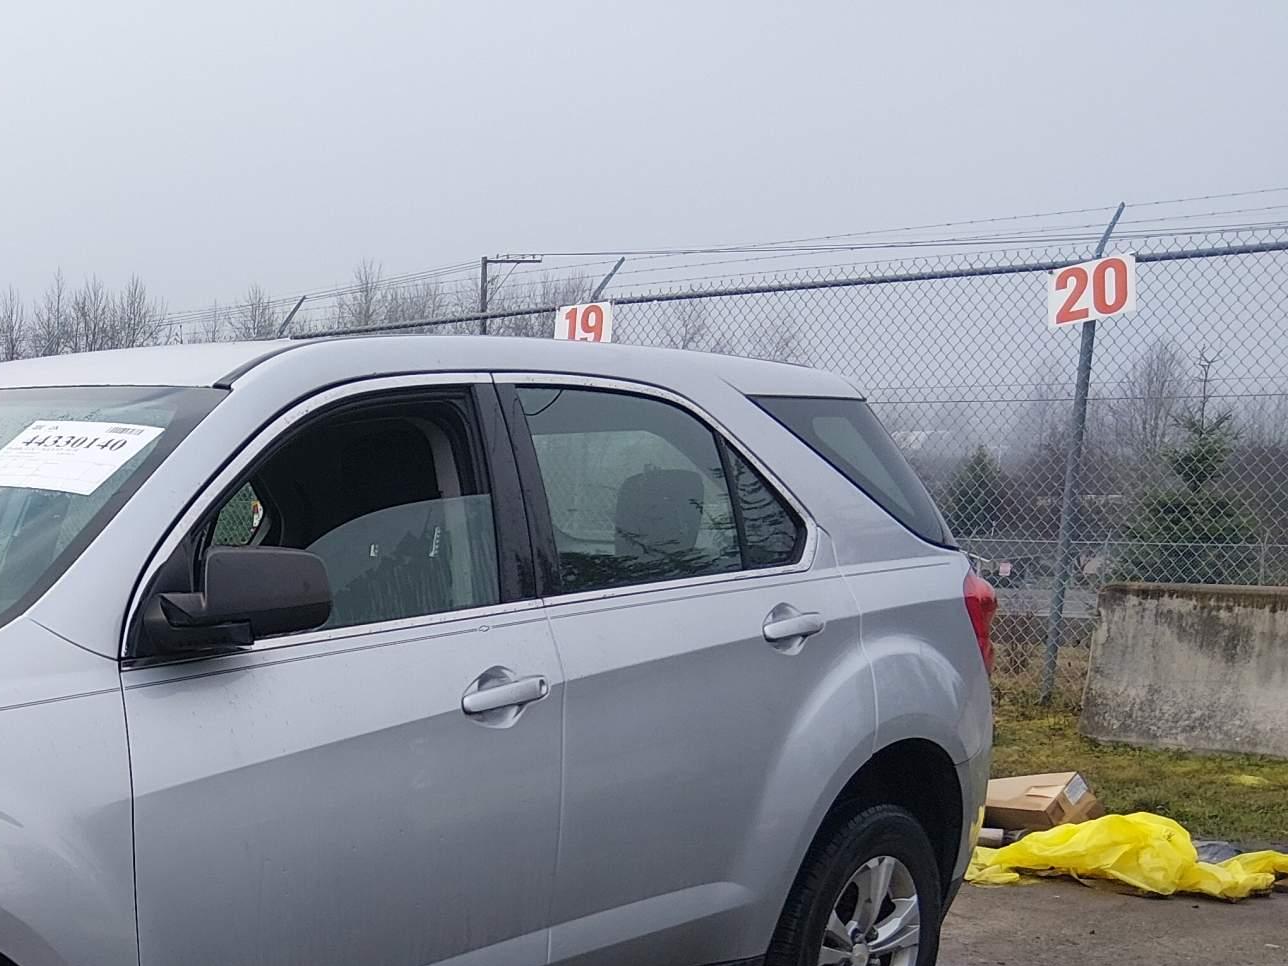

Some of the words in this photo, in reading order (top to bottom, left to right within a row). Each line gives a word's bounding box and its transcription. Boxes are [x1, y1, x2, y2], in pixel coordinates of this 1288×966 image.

[1055, 258, 1128, 324] 20
[565, 304, 604, 342] 19
[21, 434, 128, 451] 44330140
